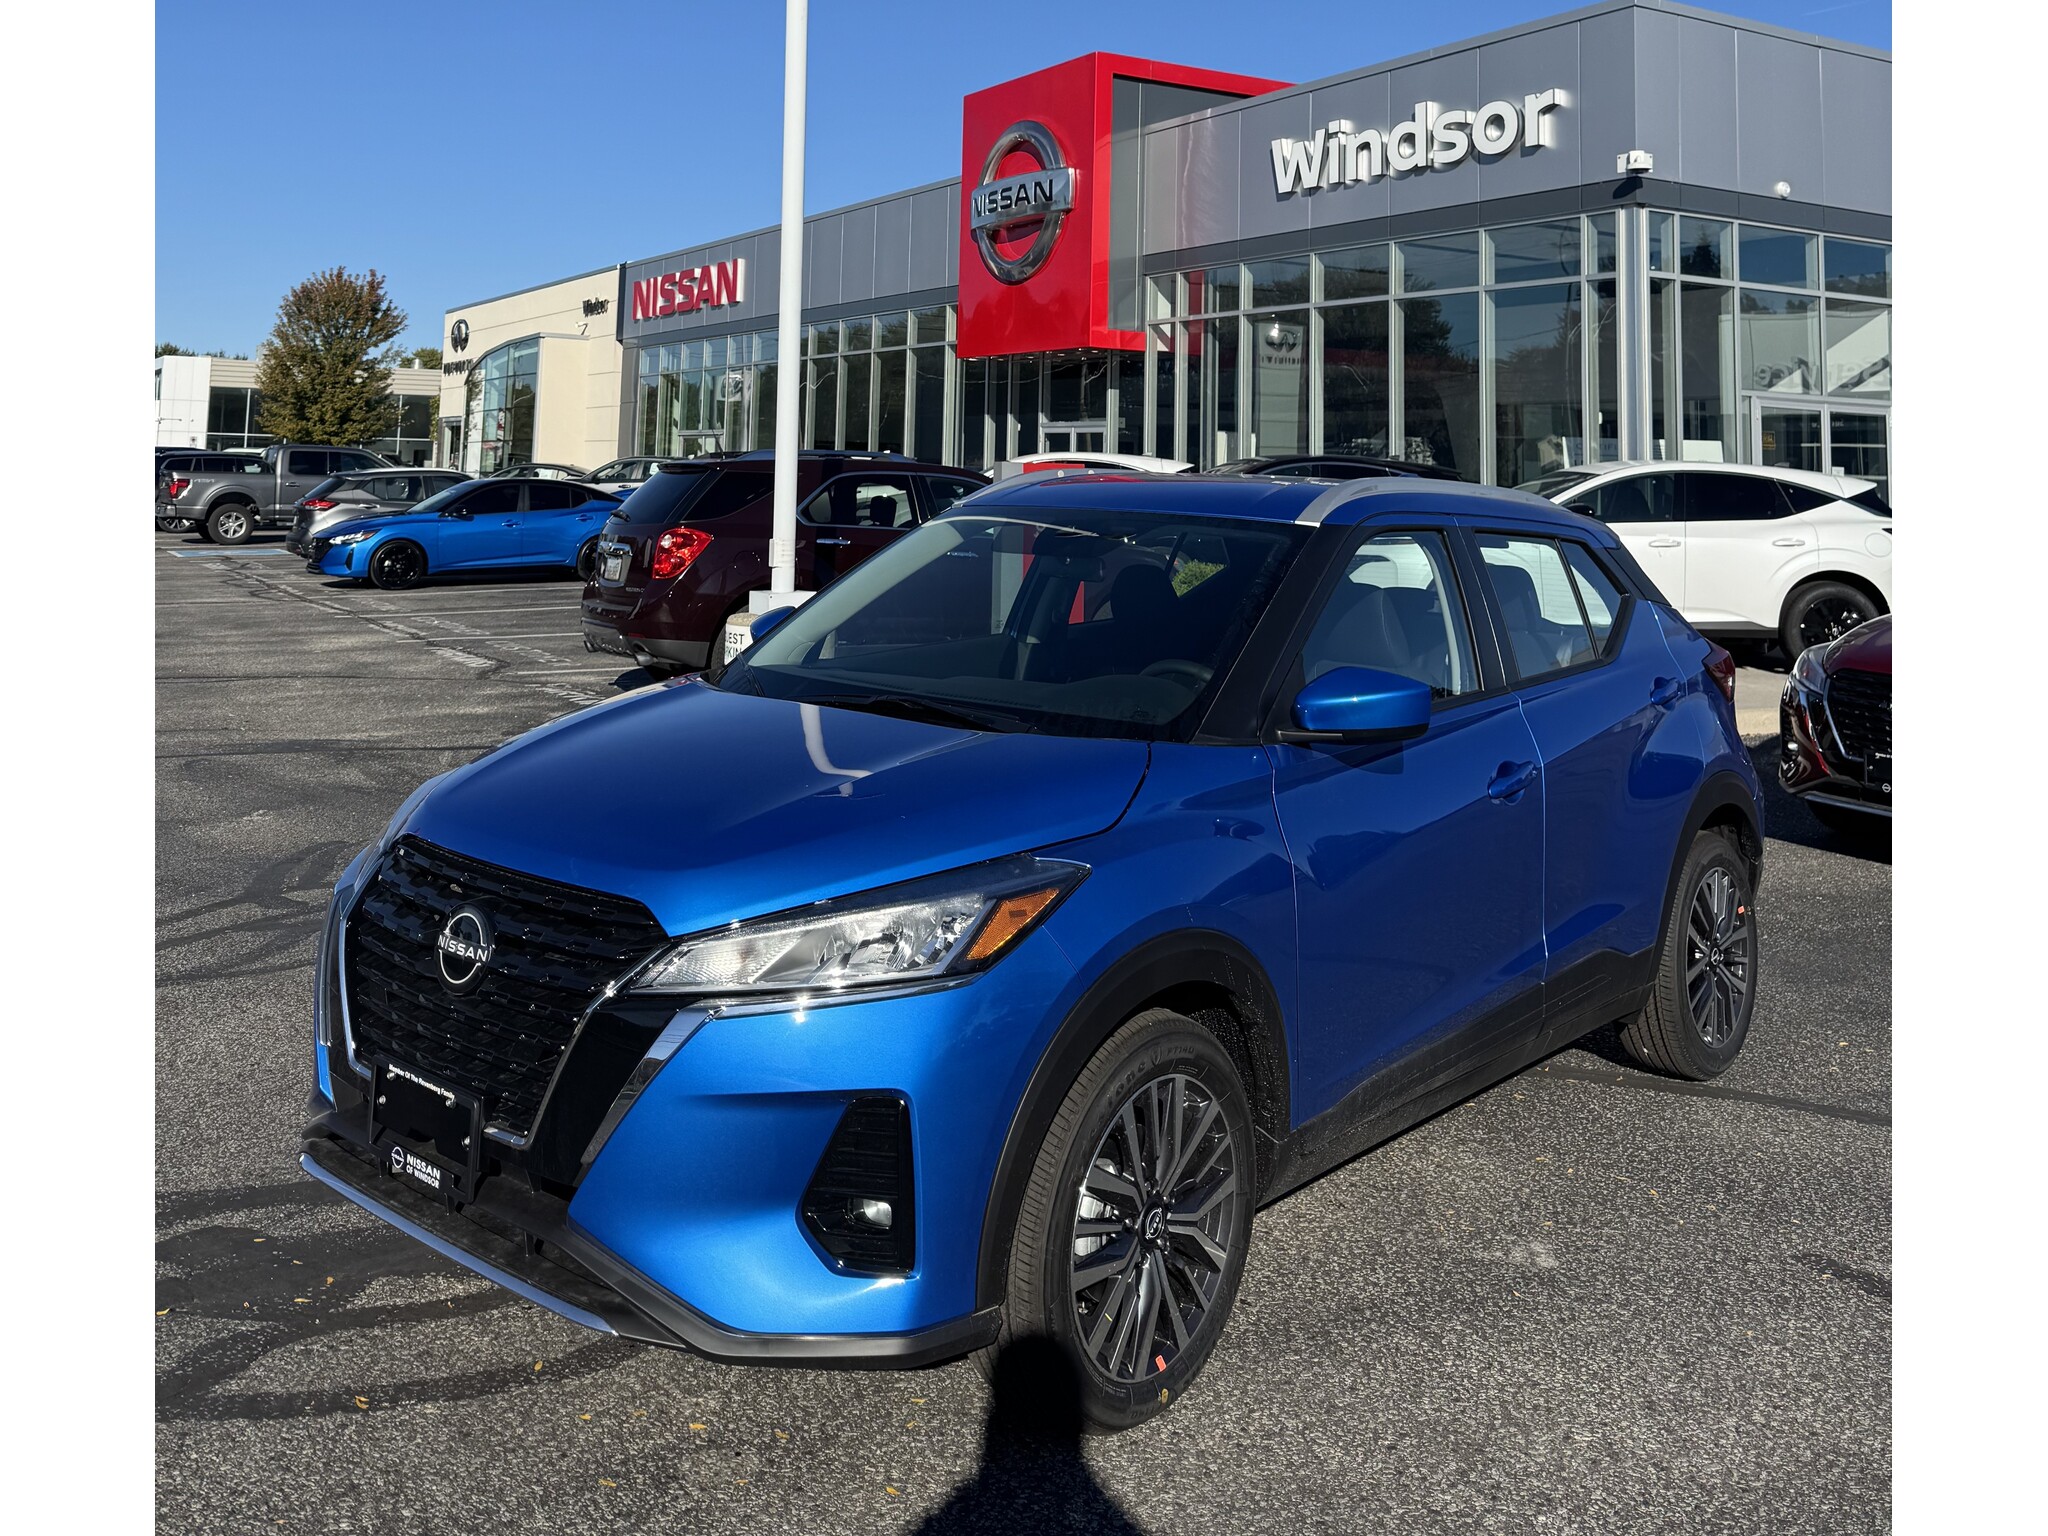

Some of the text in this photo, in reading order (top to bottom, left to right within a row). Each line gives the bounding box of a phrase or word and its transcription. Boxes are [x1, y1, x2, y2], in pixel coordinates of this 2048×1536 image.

[1271, 88, 1560, 194] Windsor
[971, 178, 1054, 219] NISSAN
[632, 258, 743, 320] NISSAN
[726, 632, 745, 645] EST
[437, 934, 488, 963] NISSAN
[405, 1164, 440, 1190] OF WINDSOR
[406, 1153, 441, 1181] NISSAN
